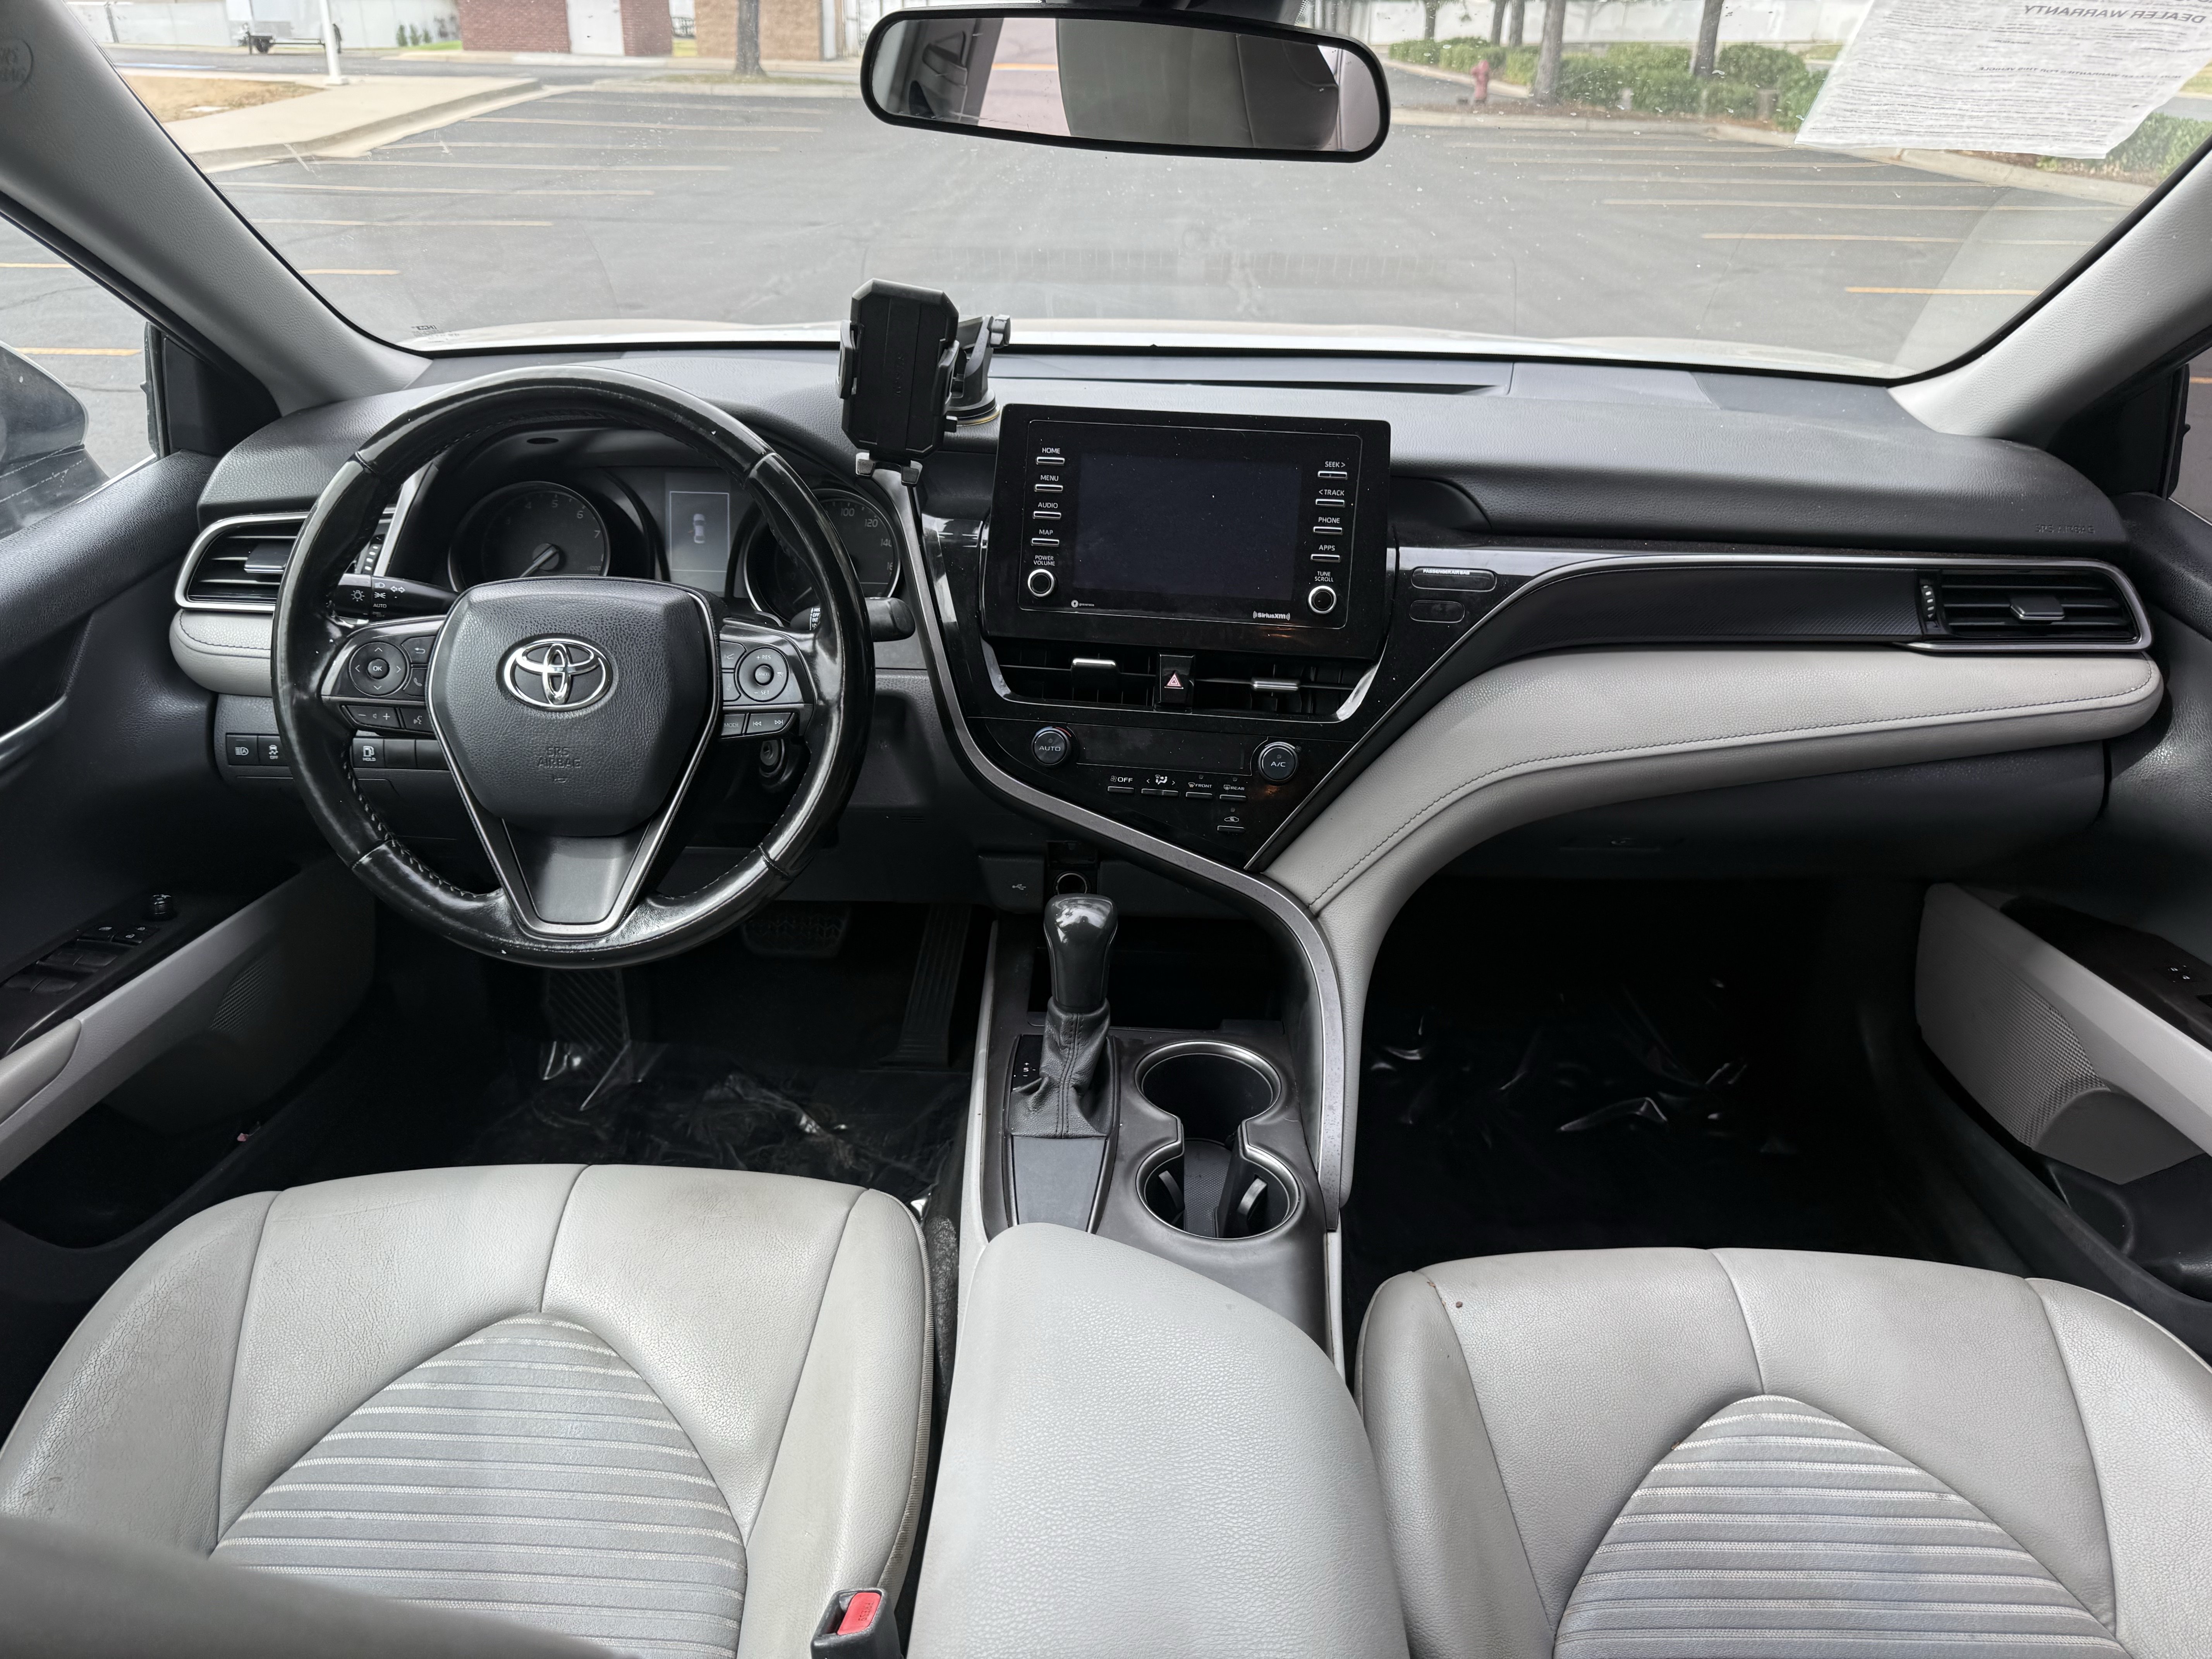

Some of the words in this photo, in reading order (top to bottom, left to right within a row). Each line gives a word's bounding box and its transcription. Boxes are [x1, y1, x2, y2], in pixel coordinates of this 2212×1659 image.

[551, 499, 559, 508] 5
[576, 510, 584, 519] 6
[841, 508, 855, 517] 100
[864, 519, 879, 528] 120
[593, 530, 601, 539] 7
[547, 747, 569, 757] SRS
[538, 758, 582, 768] AIRBAG
